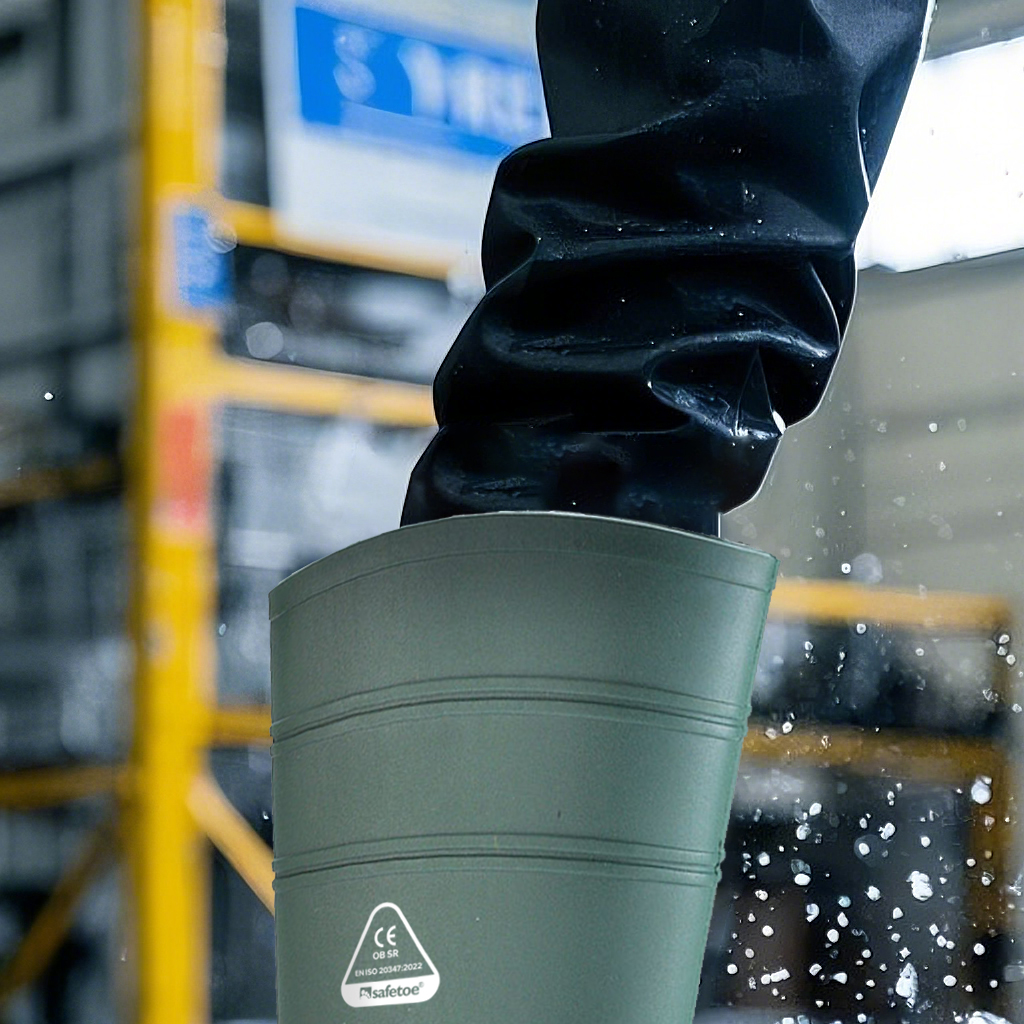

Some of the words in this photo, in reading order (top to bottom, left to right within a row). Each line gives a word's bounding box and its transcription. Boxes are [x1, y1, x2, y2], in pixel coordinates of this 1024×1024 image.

[374, 925, 396, 947] CE
[372, 951, 386, 960] OB
[387, 949, 399, 959] SR
[354, 969, 365, 977] EN
[365, 968, 378, 976] ISO
[379, 962, 423, 974] 20347:2022
